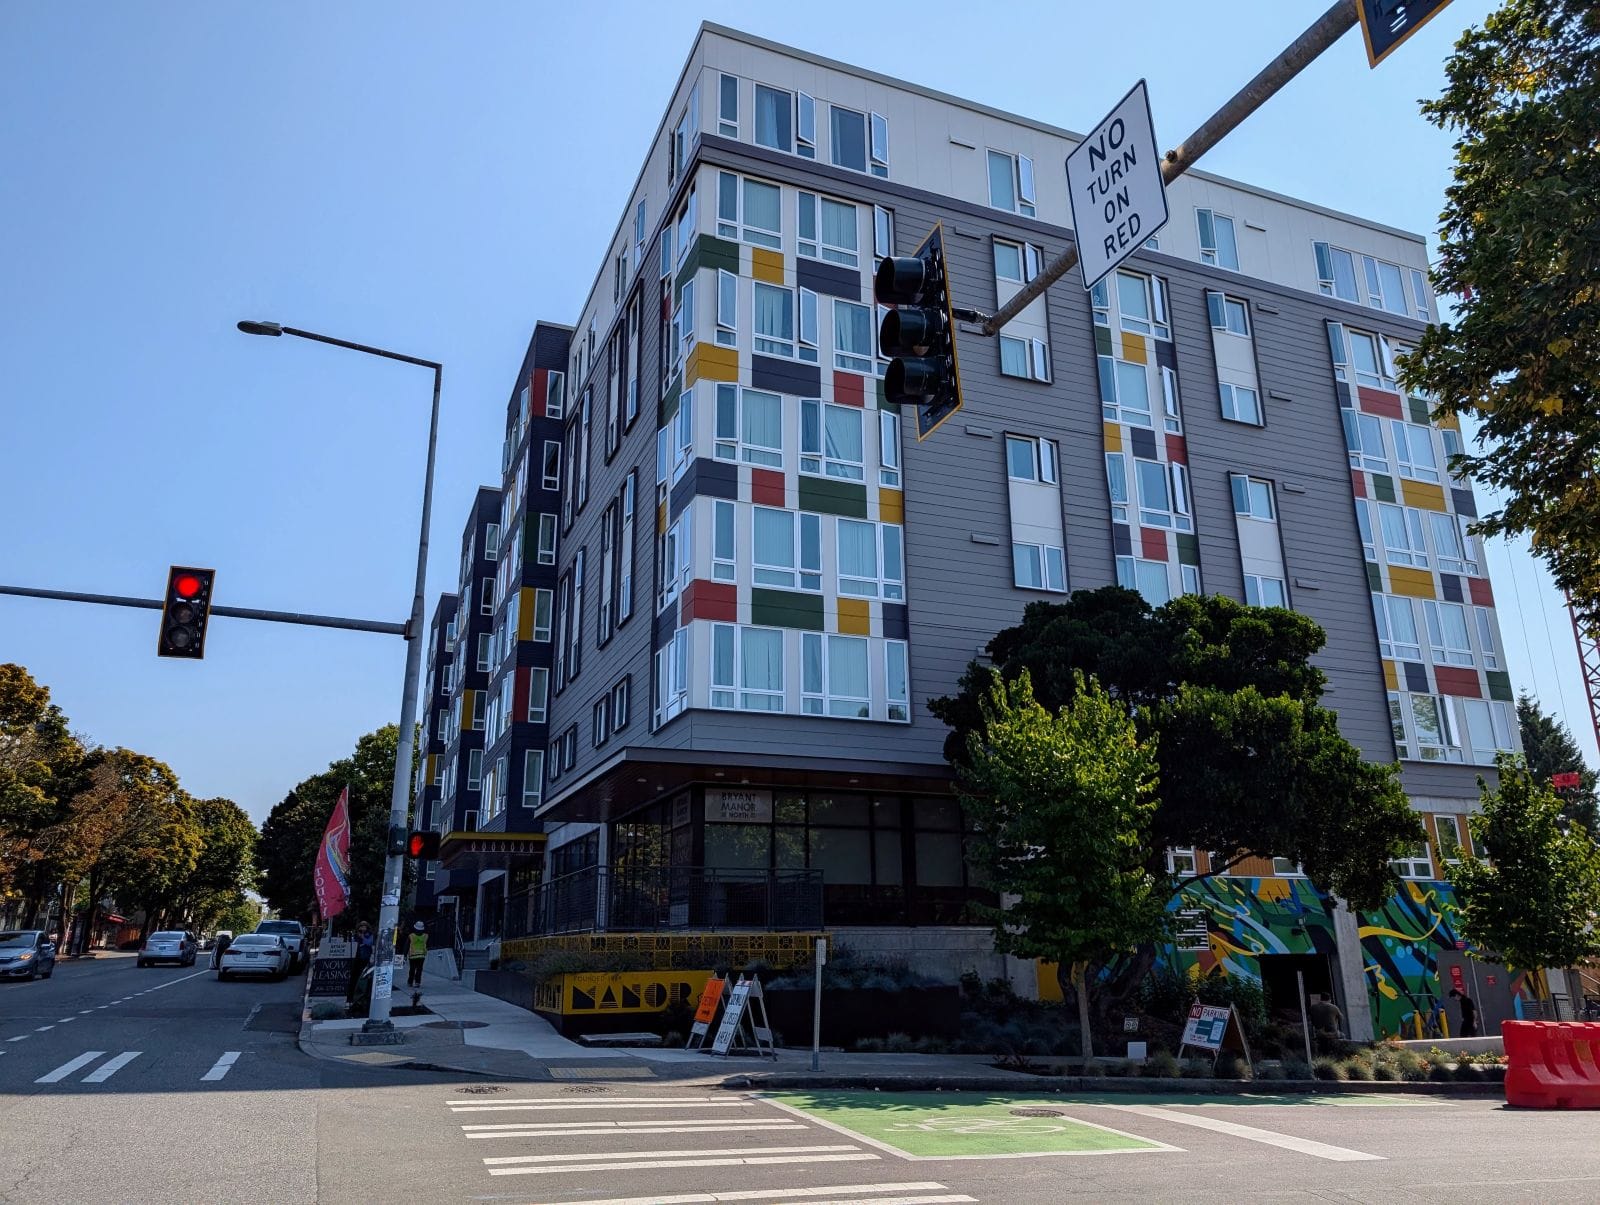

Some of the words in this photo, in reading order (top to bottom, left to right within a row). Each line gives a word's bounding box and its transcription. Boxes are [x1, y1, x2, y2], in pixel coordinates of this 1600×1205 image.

[1088, 118, 1125, 172] NO
[1087, 144, 1137, 204] TURN
[1104, 186, 1130, 224] ON
[1104, 213, 1141, 260] RED
[721, 791, 756, 801] BRYANT
[721, 803, 756, 811] MANOR
[313, 970, 351, 980] LEASING
[321, 961, 347, 970] NOW
[572, 982, 692, 1009] MANOR
[1190, 1007, 1202, 1018] NO
[1203, 1008, 1229, 1019] PARKING
